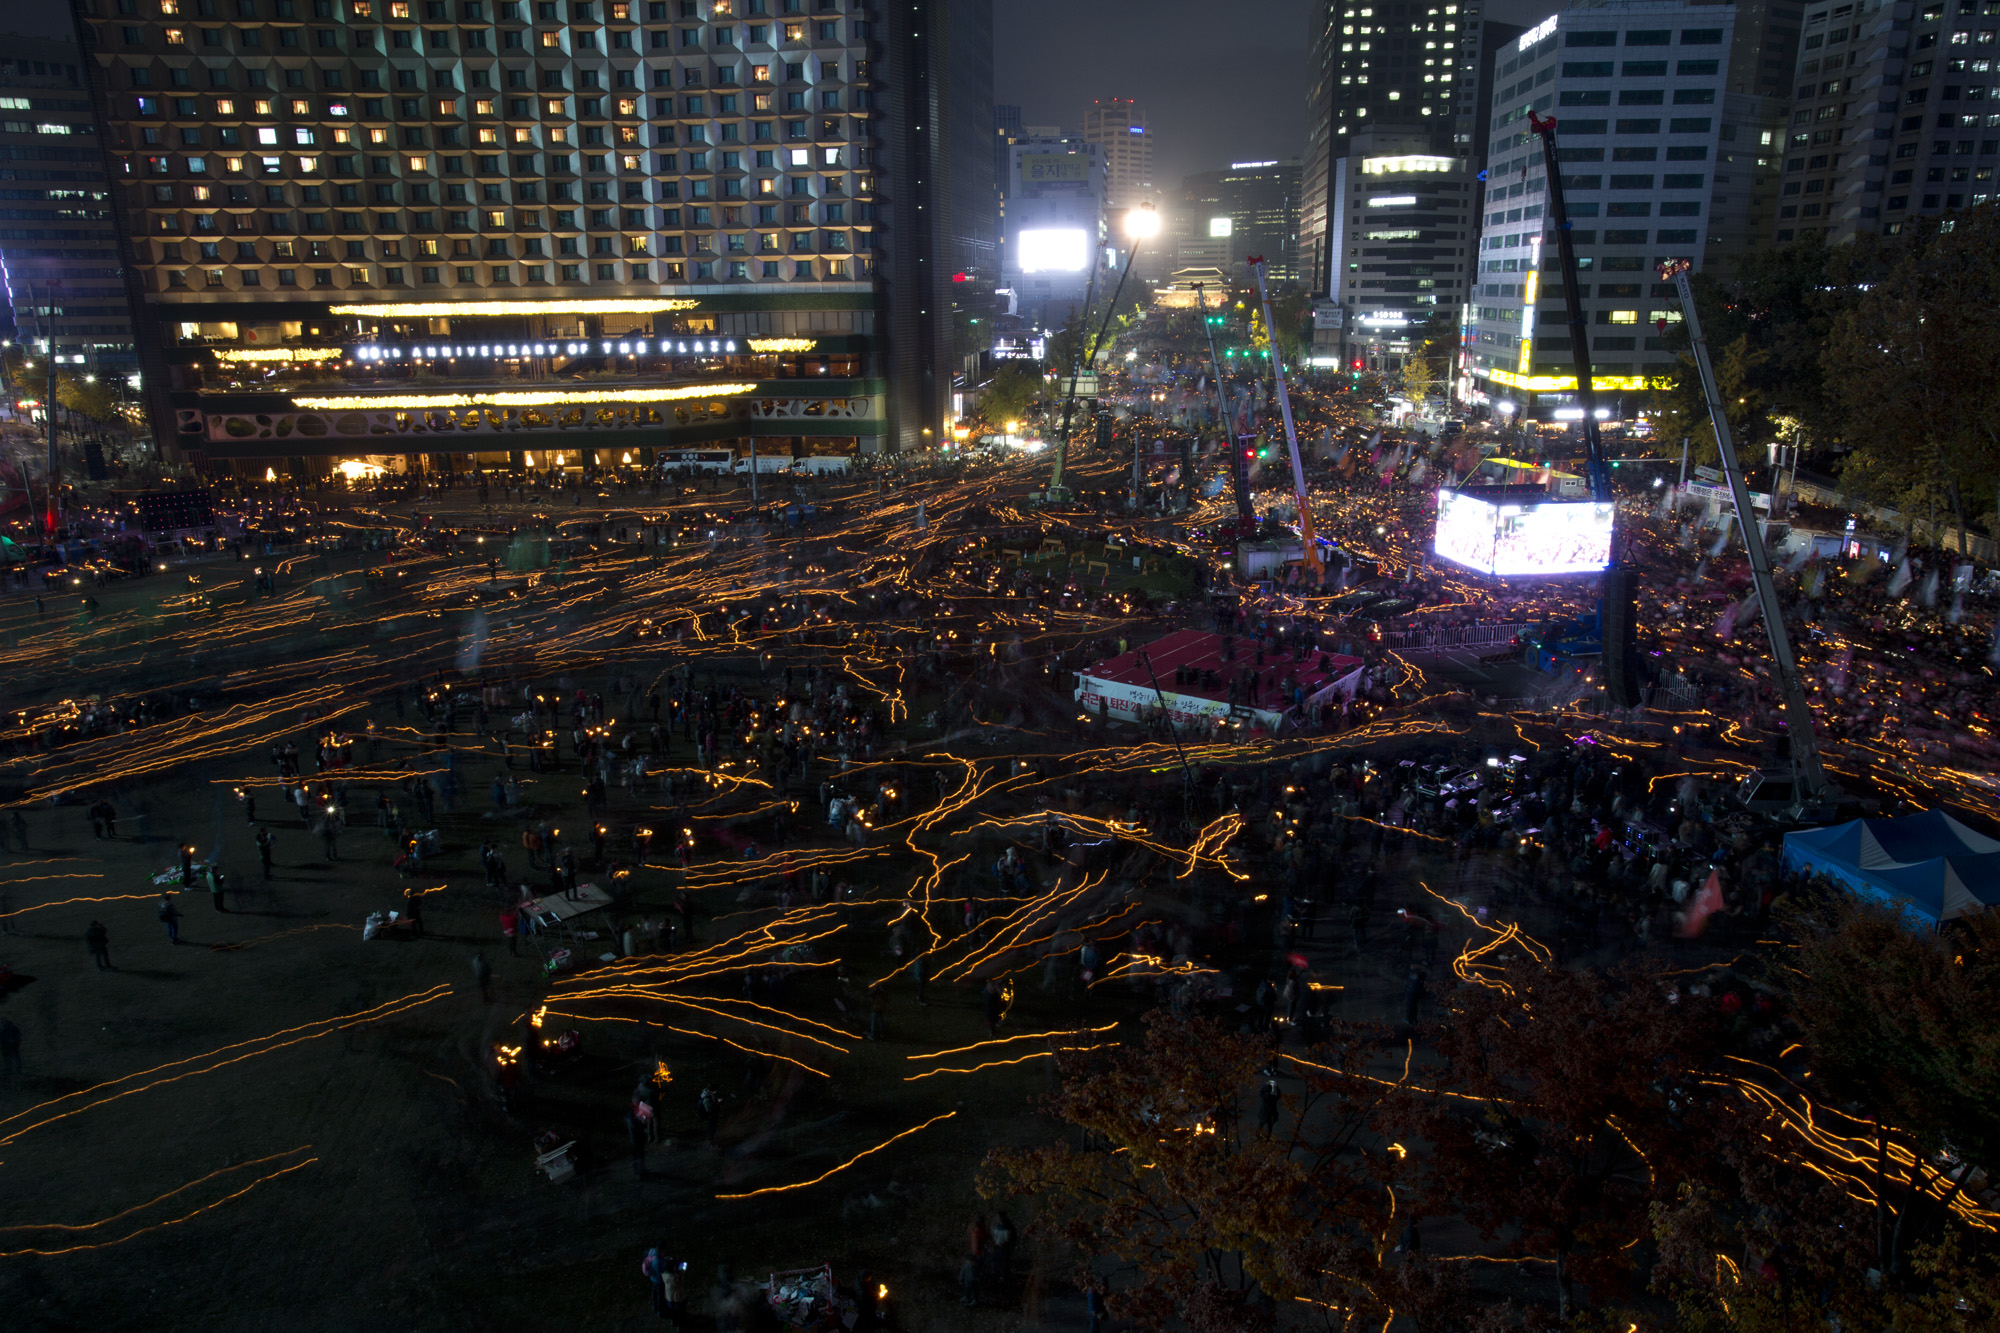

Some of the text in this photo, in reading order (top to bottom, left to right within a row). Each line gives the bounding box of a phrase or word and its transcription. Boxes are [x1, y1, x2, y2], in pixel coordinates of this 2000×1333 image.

[1032, 164, 1060, 179] 을지
[1681, 277, 1690, 299] KATO
[412, 344, 557, 357] ANNIVERSARY
[568, 343, 588, 355] OF
[603, 341, 647, 354] THE
[662, 340, 737, 354] PLAZA
[1110, 697, 1128, 712] 퇴진
